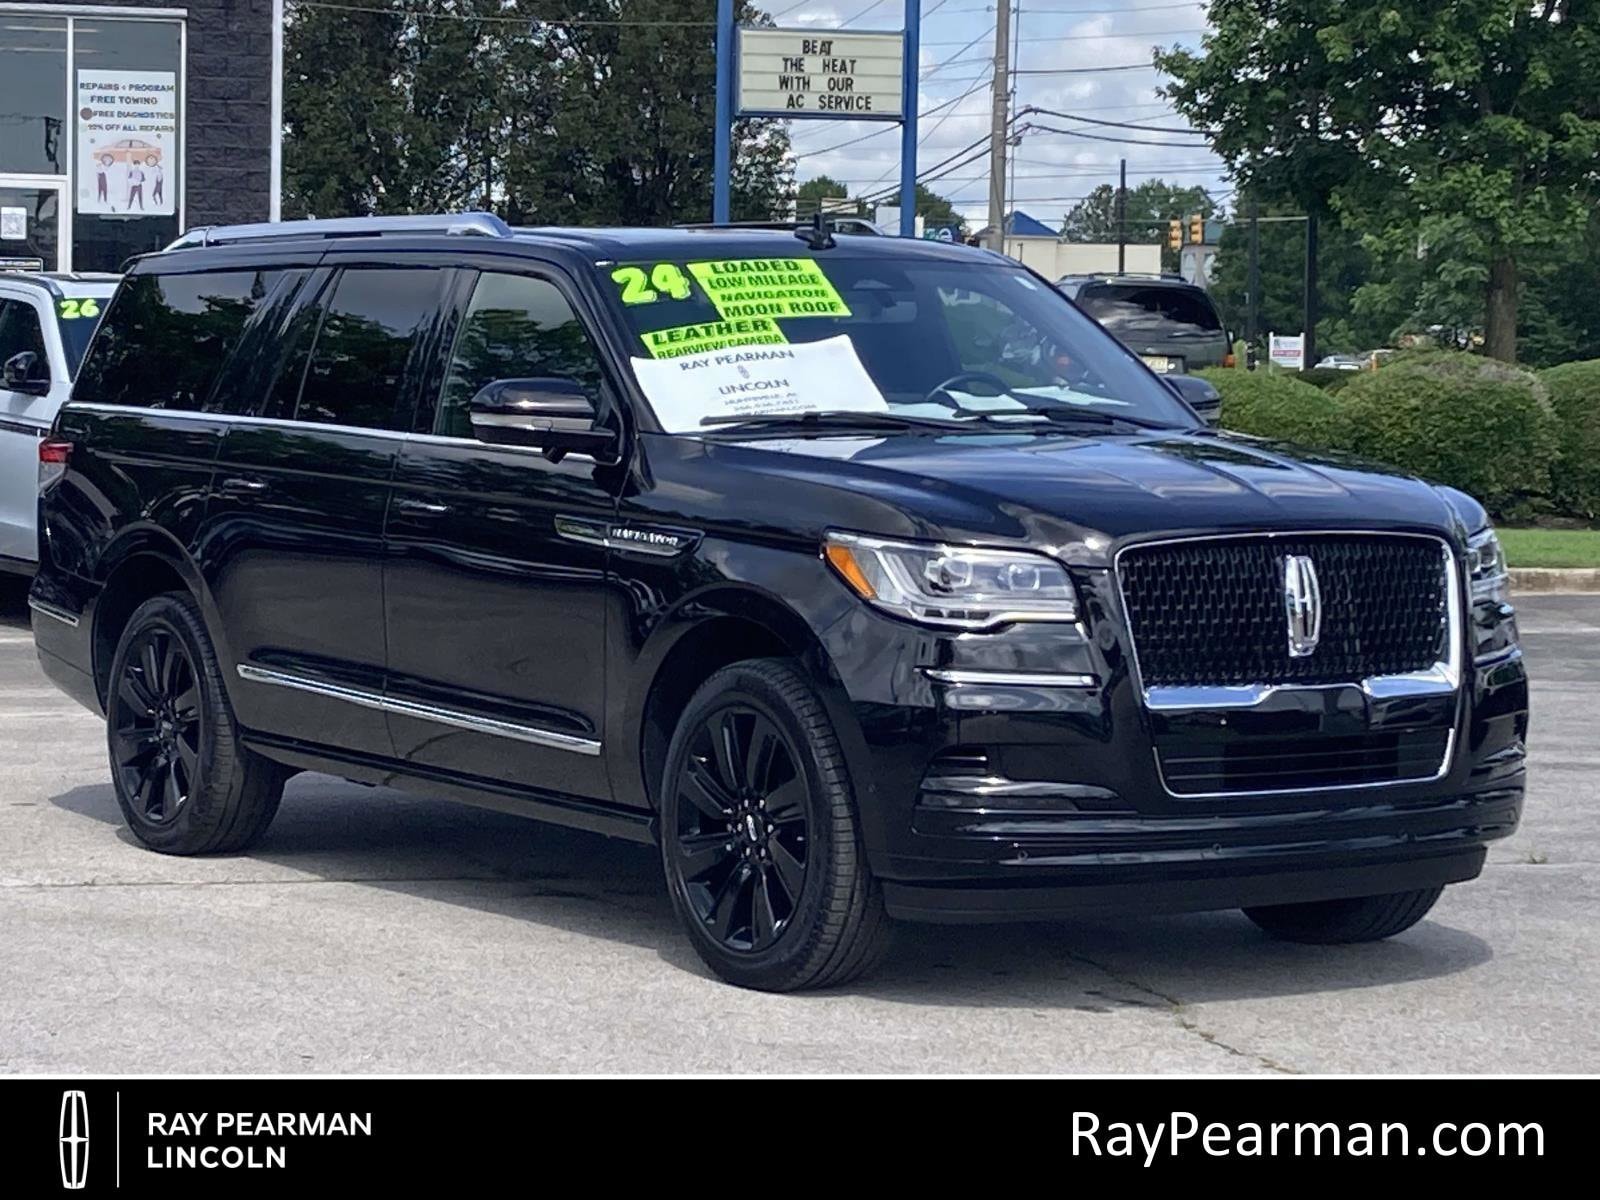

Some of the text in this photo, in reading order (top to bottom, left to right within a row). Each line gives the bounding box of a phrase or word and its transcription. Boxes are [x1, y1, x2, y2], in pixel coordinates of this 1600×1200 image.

[802, 39, 833, 55] BEAT
[782, 57, 856, 74] THE HEAT
[79, 82, 120, 91] REPAIRS
[128, 83, 175, 92] PROGRAM
[778, 75, 854, 92] WITH OUR
[90, 95, 158, 104] FREE TOWING
[786, 94, 872, 111] AC SERVICE
[117, 110, 175, 119] DIAGNOSTICS
[710, 260, 803, 274] LOADED
[611, 264, 692, 304] 24
[707, 273, 822, 289] LOW MILEAGE
[720, 288, 829, 302] NAVIGATION
[60, 298, 100, 319] 26
[723, 301, 841, 318] MOON ROOF
[652, 320, 772, 346] LEATHER
[656, 334, 784, 360] REARVIEW CAMERA
[680, 349, 795, 371] RAY PEARMAN
[719, 379, 790, 395] LINCOLN
